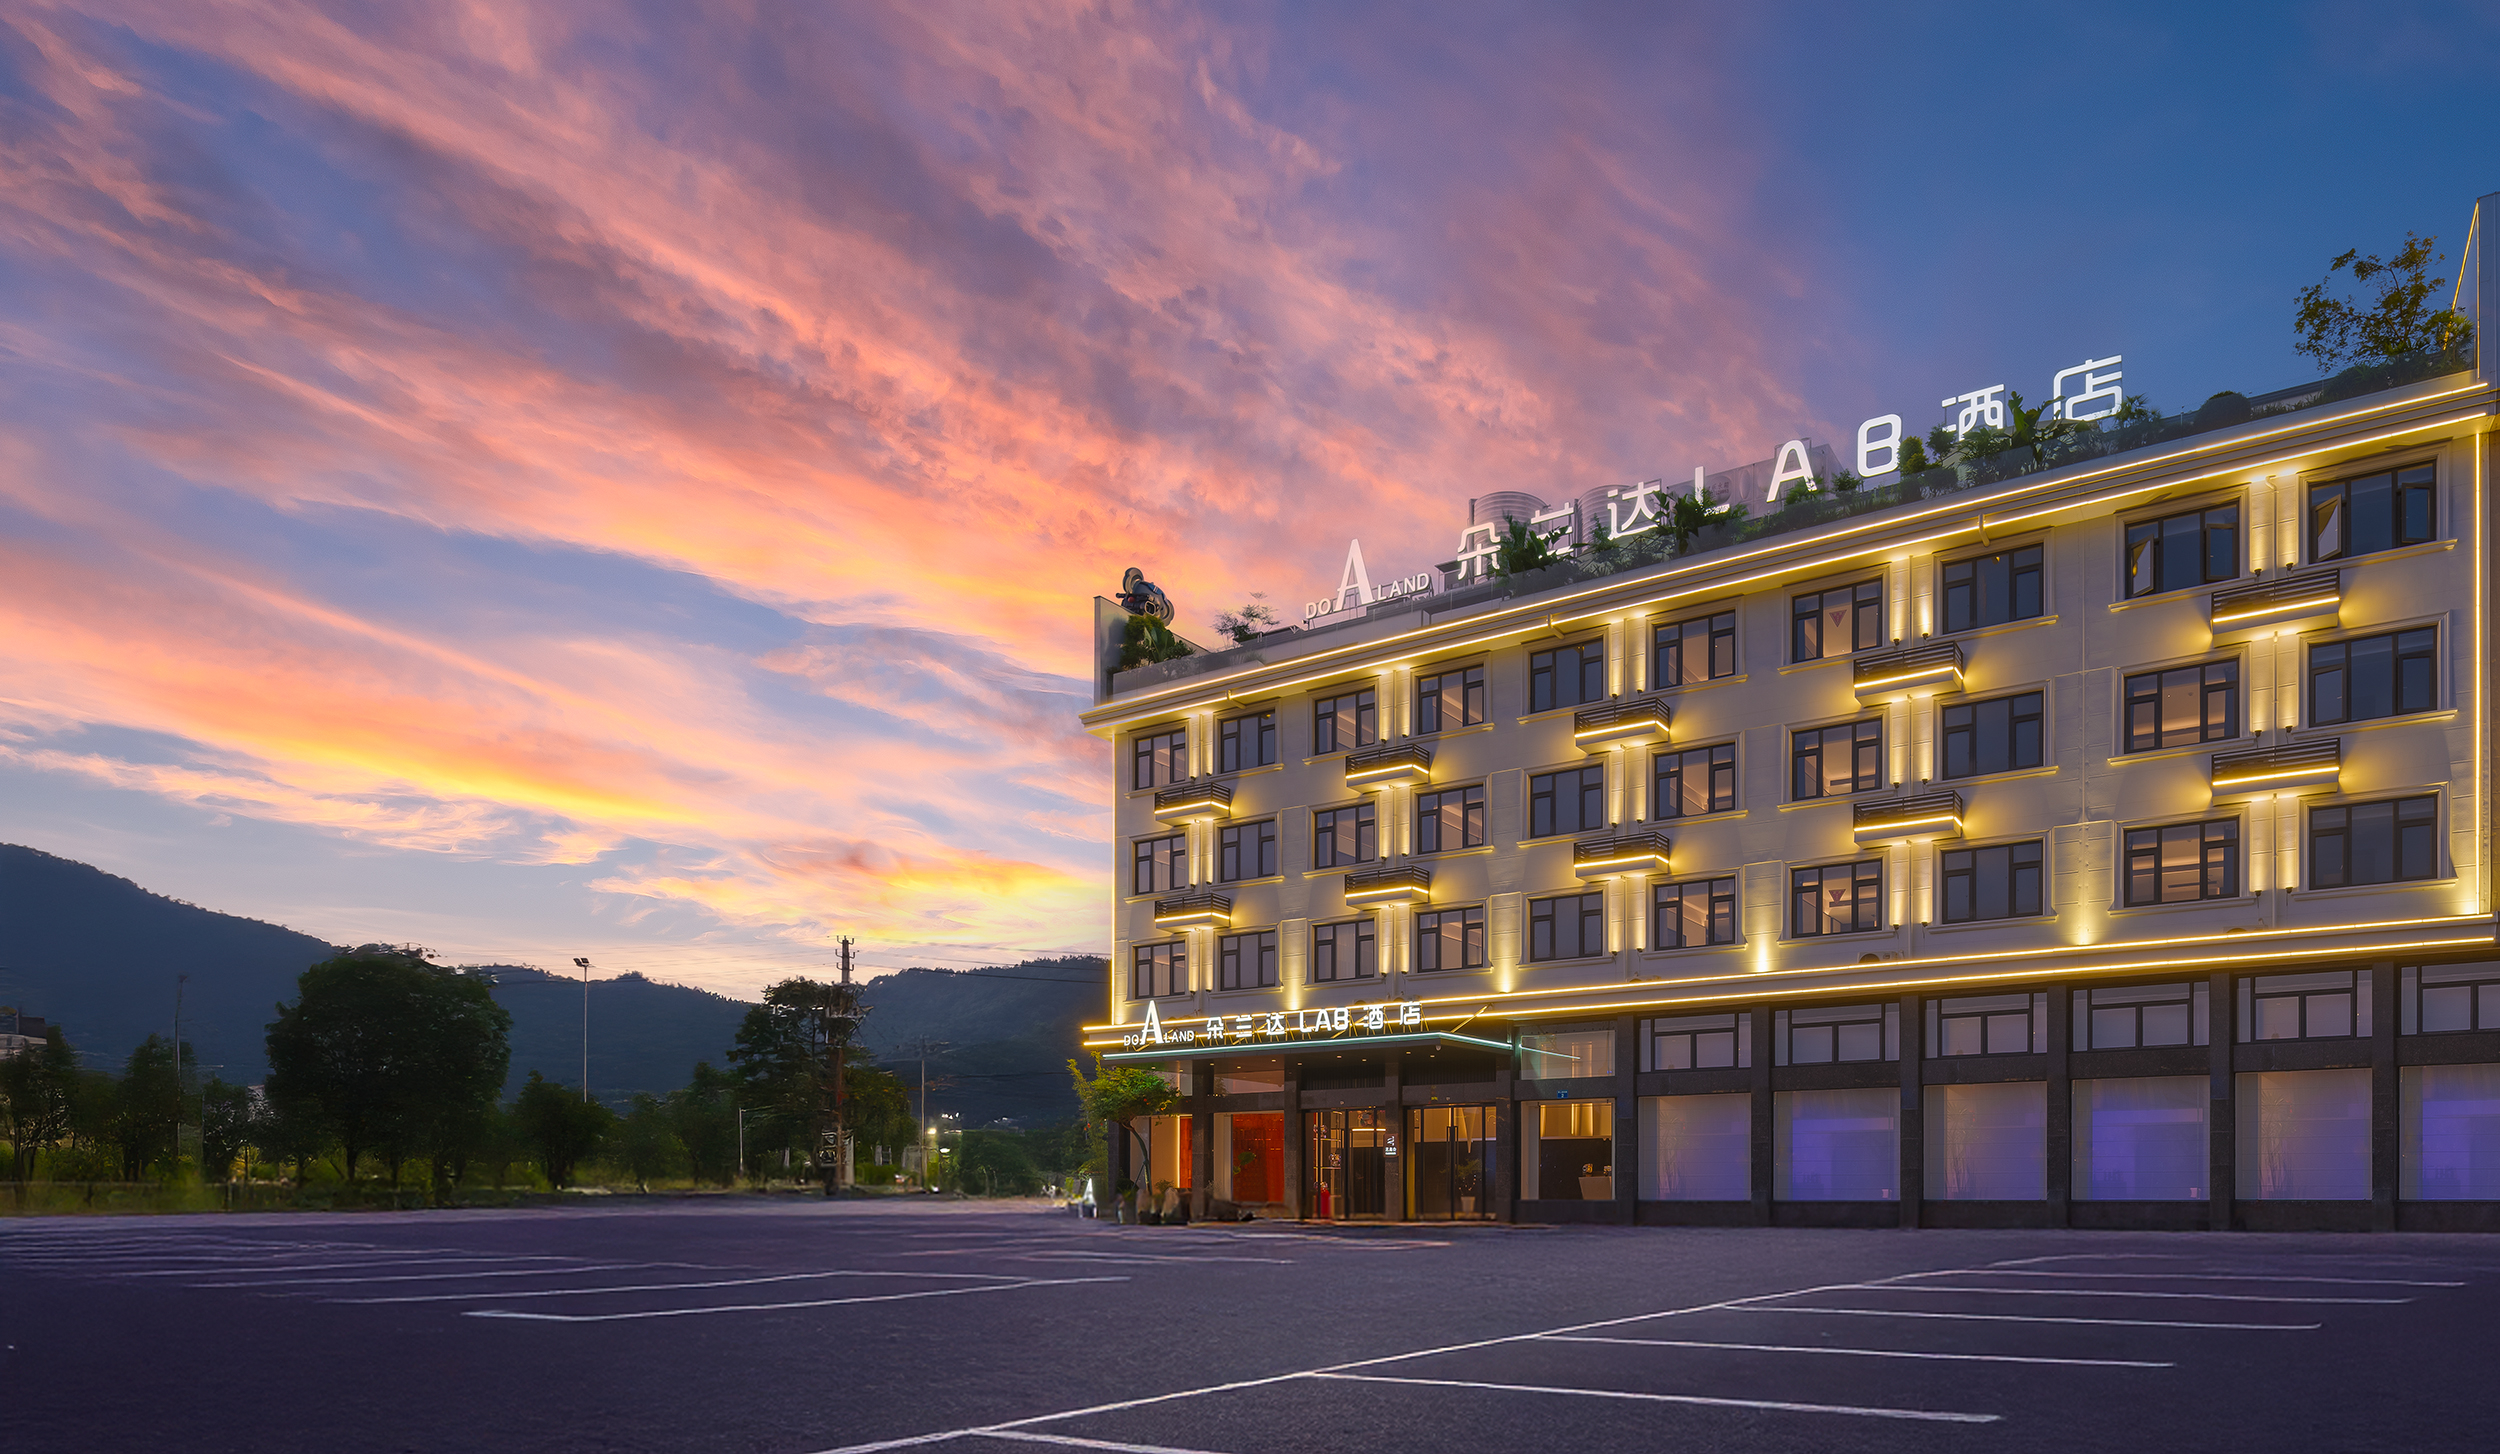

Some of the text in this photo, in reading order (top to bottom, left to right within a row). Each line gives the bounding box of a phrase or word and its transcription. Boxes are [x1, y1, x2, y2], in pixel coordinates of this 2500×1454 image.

[1941, 355, 2123, 442] 酒店
[1300, 1006, 1349, 1033] LAB
[1363, 1001, 1421, 1030] 酒店
